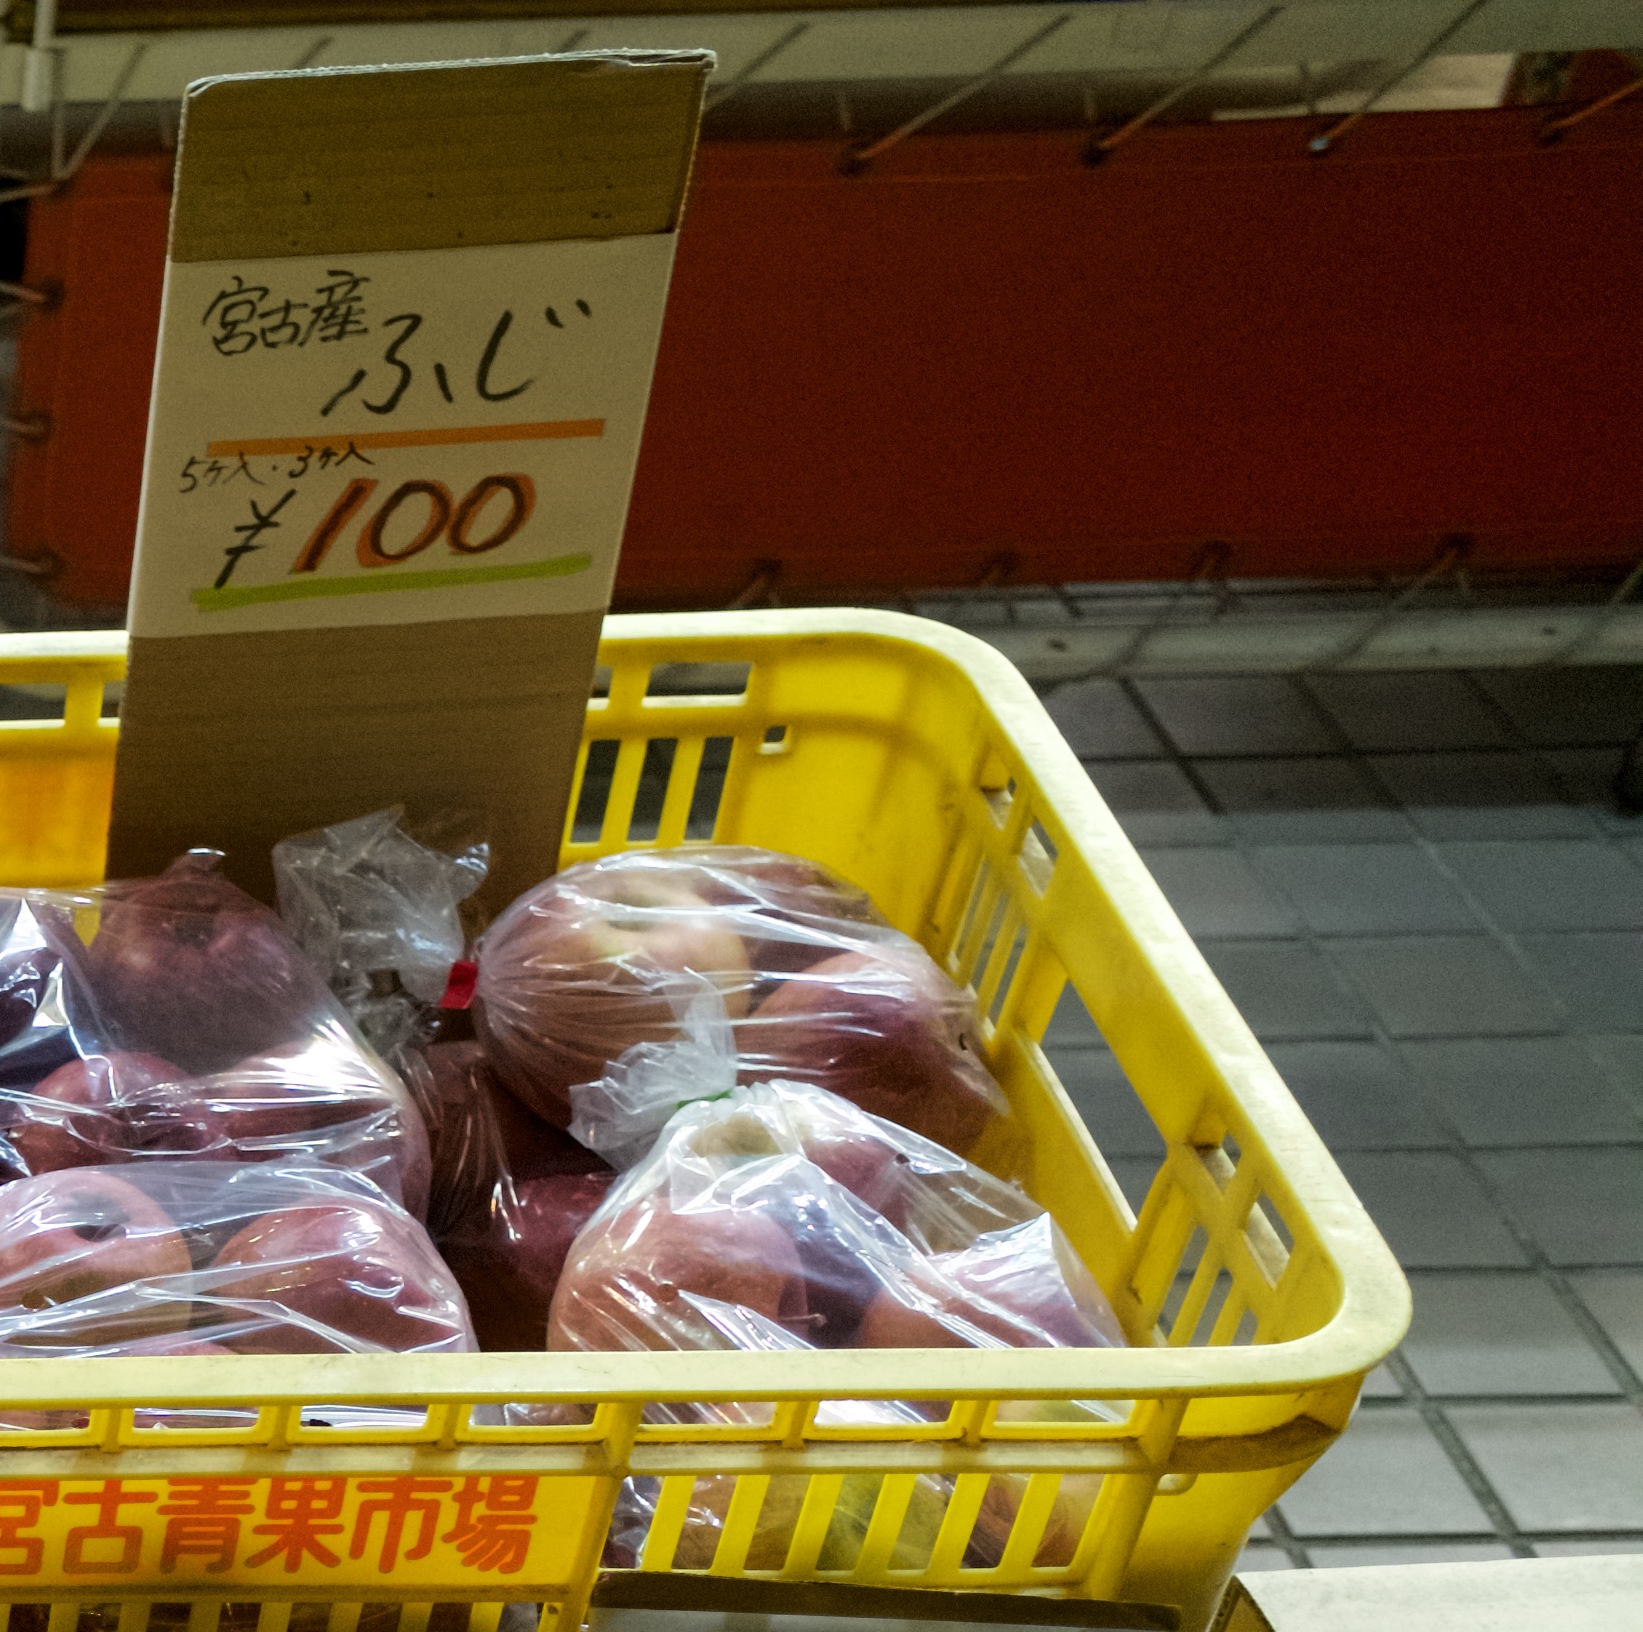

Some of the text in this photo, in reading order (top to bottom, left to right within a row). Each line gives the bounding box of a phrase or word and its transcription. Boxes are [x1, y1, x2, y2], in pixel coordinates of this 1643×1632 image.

[202, 269, 371, 355] 宮古産
[321, 299, 593, 417] ふじ
[215, 473, 537, 589] ¥100
